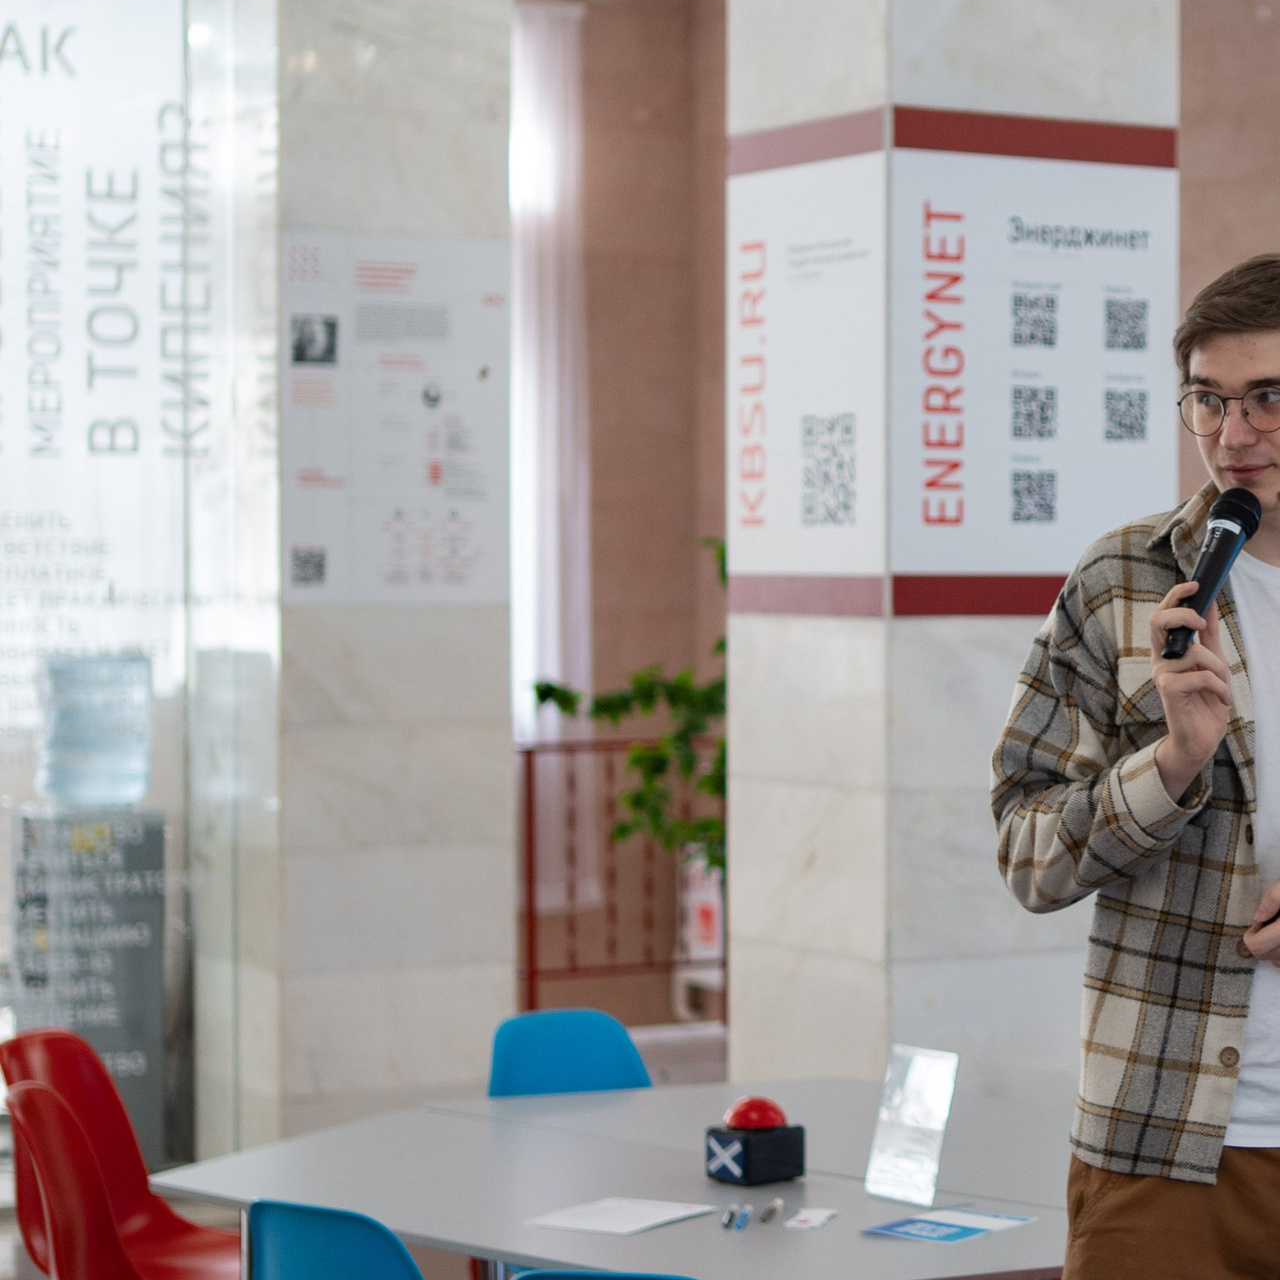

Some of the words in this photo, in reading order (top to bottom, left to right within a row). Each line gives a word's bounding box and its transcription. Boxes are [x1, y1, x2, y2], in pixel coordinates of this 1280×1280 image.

[26, 127, 63, 458] МЕРОПРИЯТИЕ
[86, 167, 140, 392] ТОЧКЕ
[1007, 214, 1150, 251] Энерджинет
[87, 416, 140, 457] В
[739, 239, 767, 528] KBSU.RU
[922, 200, 966, 527] ENERGYNET
